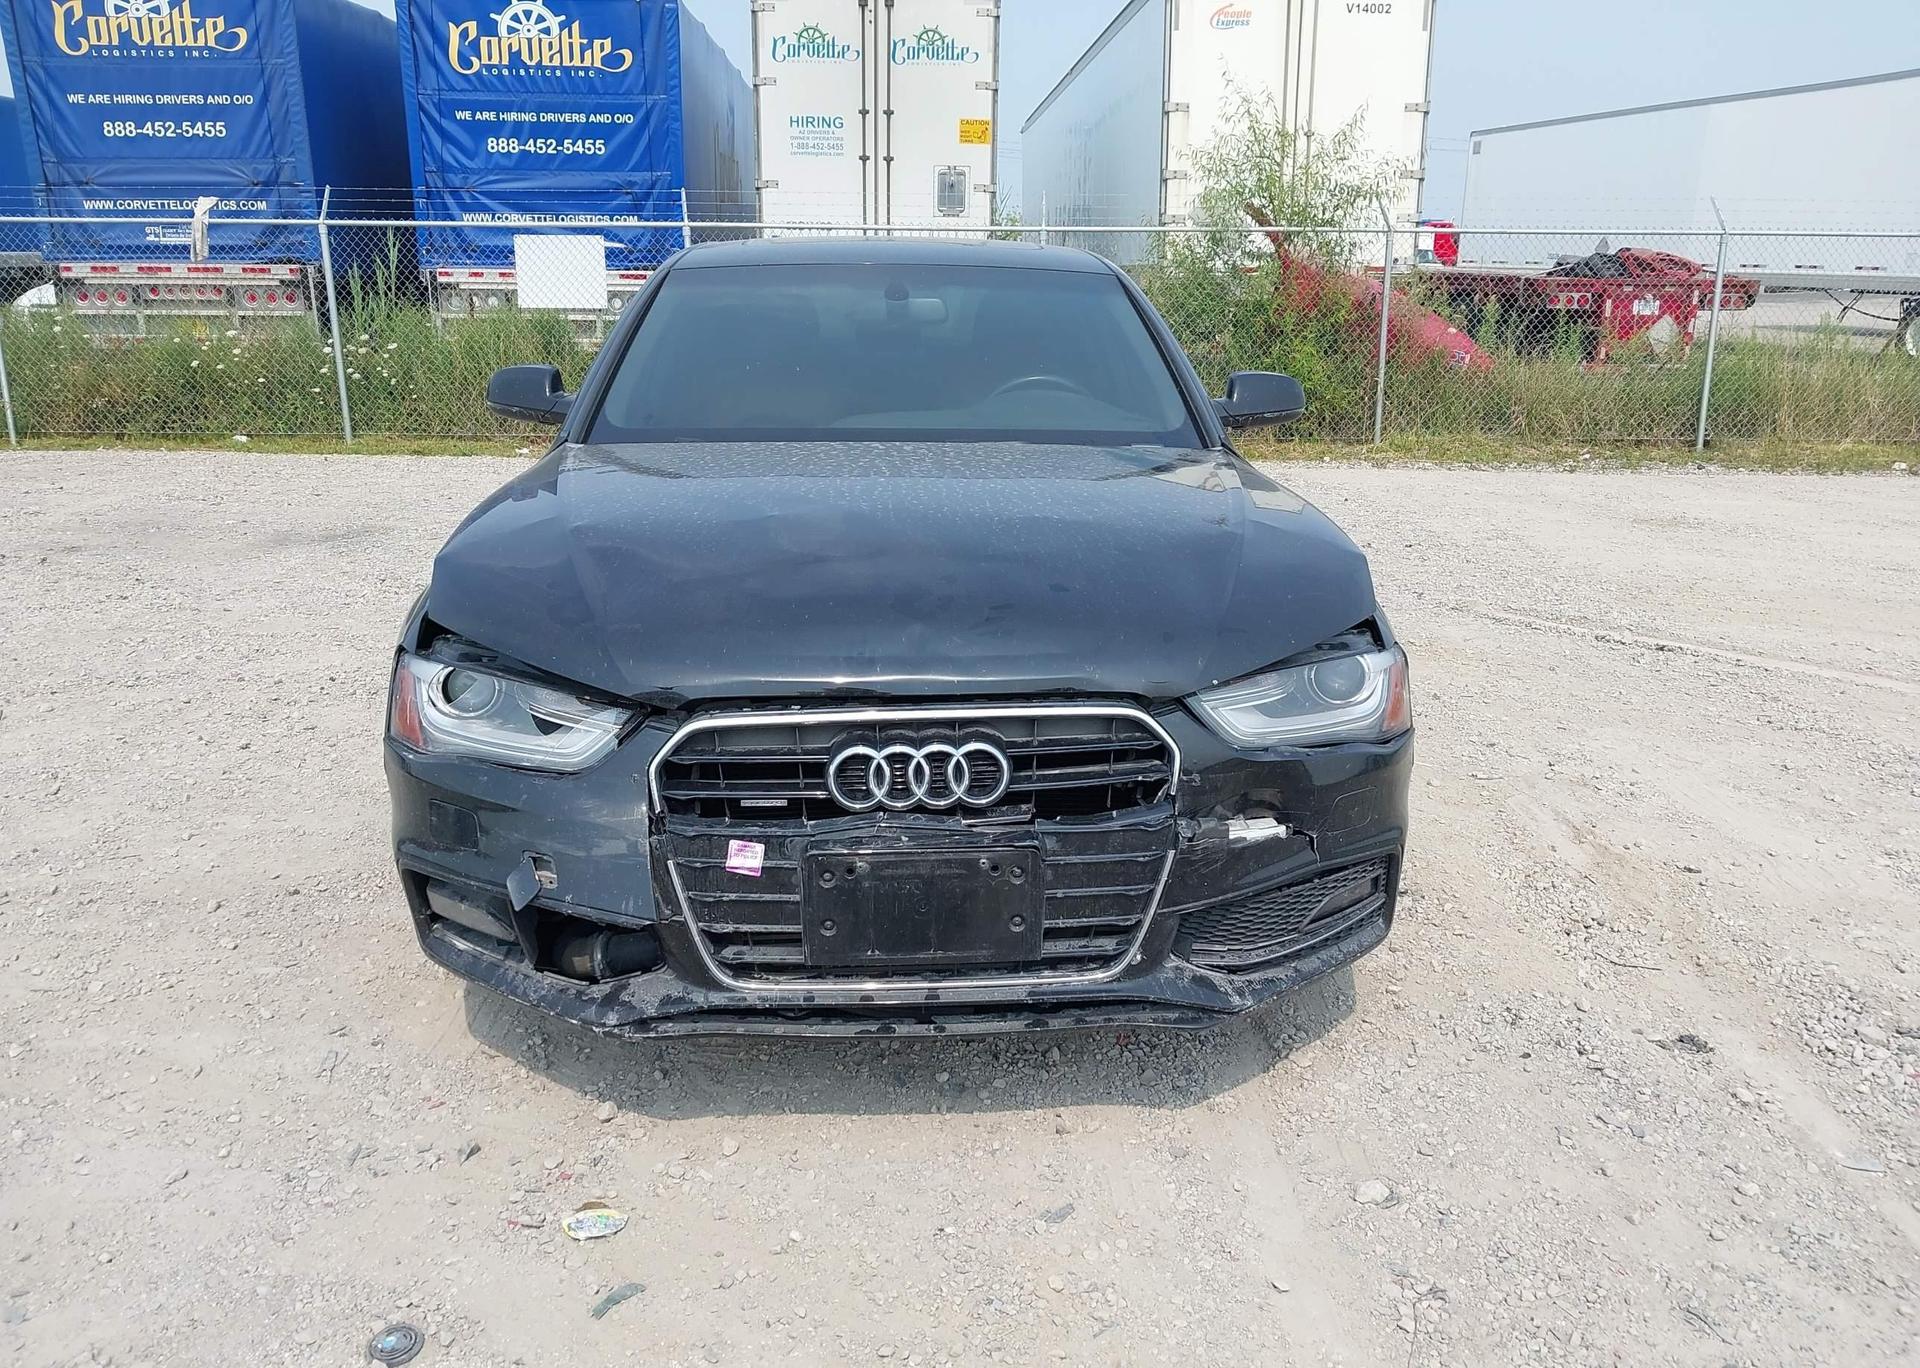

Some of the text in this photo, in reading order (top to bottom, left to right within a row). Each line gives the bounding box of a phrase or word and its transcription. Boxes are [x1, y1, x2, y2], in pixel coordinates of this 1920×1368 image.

[1346, 3, 1392, 14] V14002
[52, 0, 248, 56] Corvette
[1216, 18, 1251, 27] Express
[92, 49, 175, 57] LOGISTICS
[448, 19, 633, 75] Corvette
[771, 35, 860, 63] Corvette
[891, 37, 979, 66] Corvette
[482, 67, 603, 78] LOGISTICS INC.
[67, 93, 254, 105] WE ARE HIRING DRIVERS AND O/O
[455, 110, 634, 124] WE ARE HIRING DRIVERS AND O/O
[790, 115, 844, 129] HIRING
[103, 121, 226, 138] 888-452-5455
[487, 137, 606, 155] 888-452-5455
[791, 142, 844, 151] 1-888-452-5455
[83, 199, 267, 211] WWW.CORVETTELOGICS.COM
